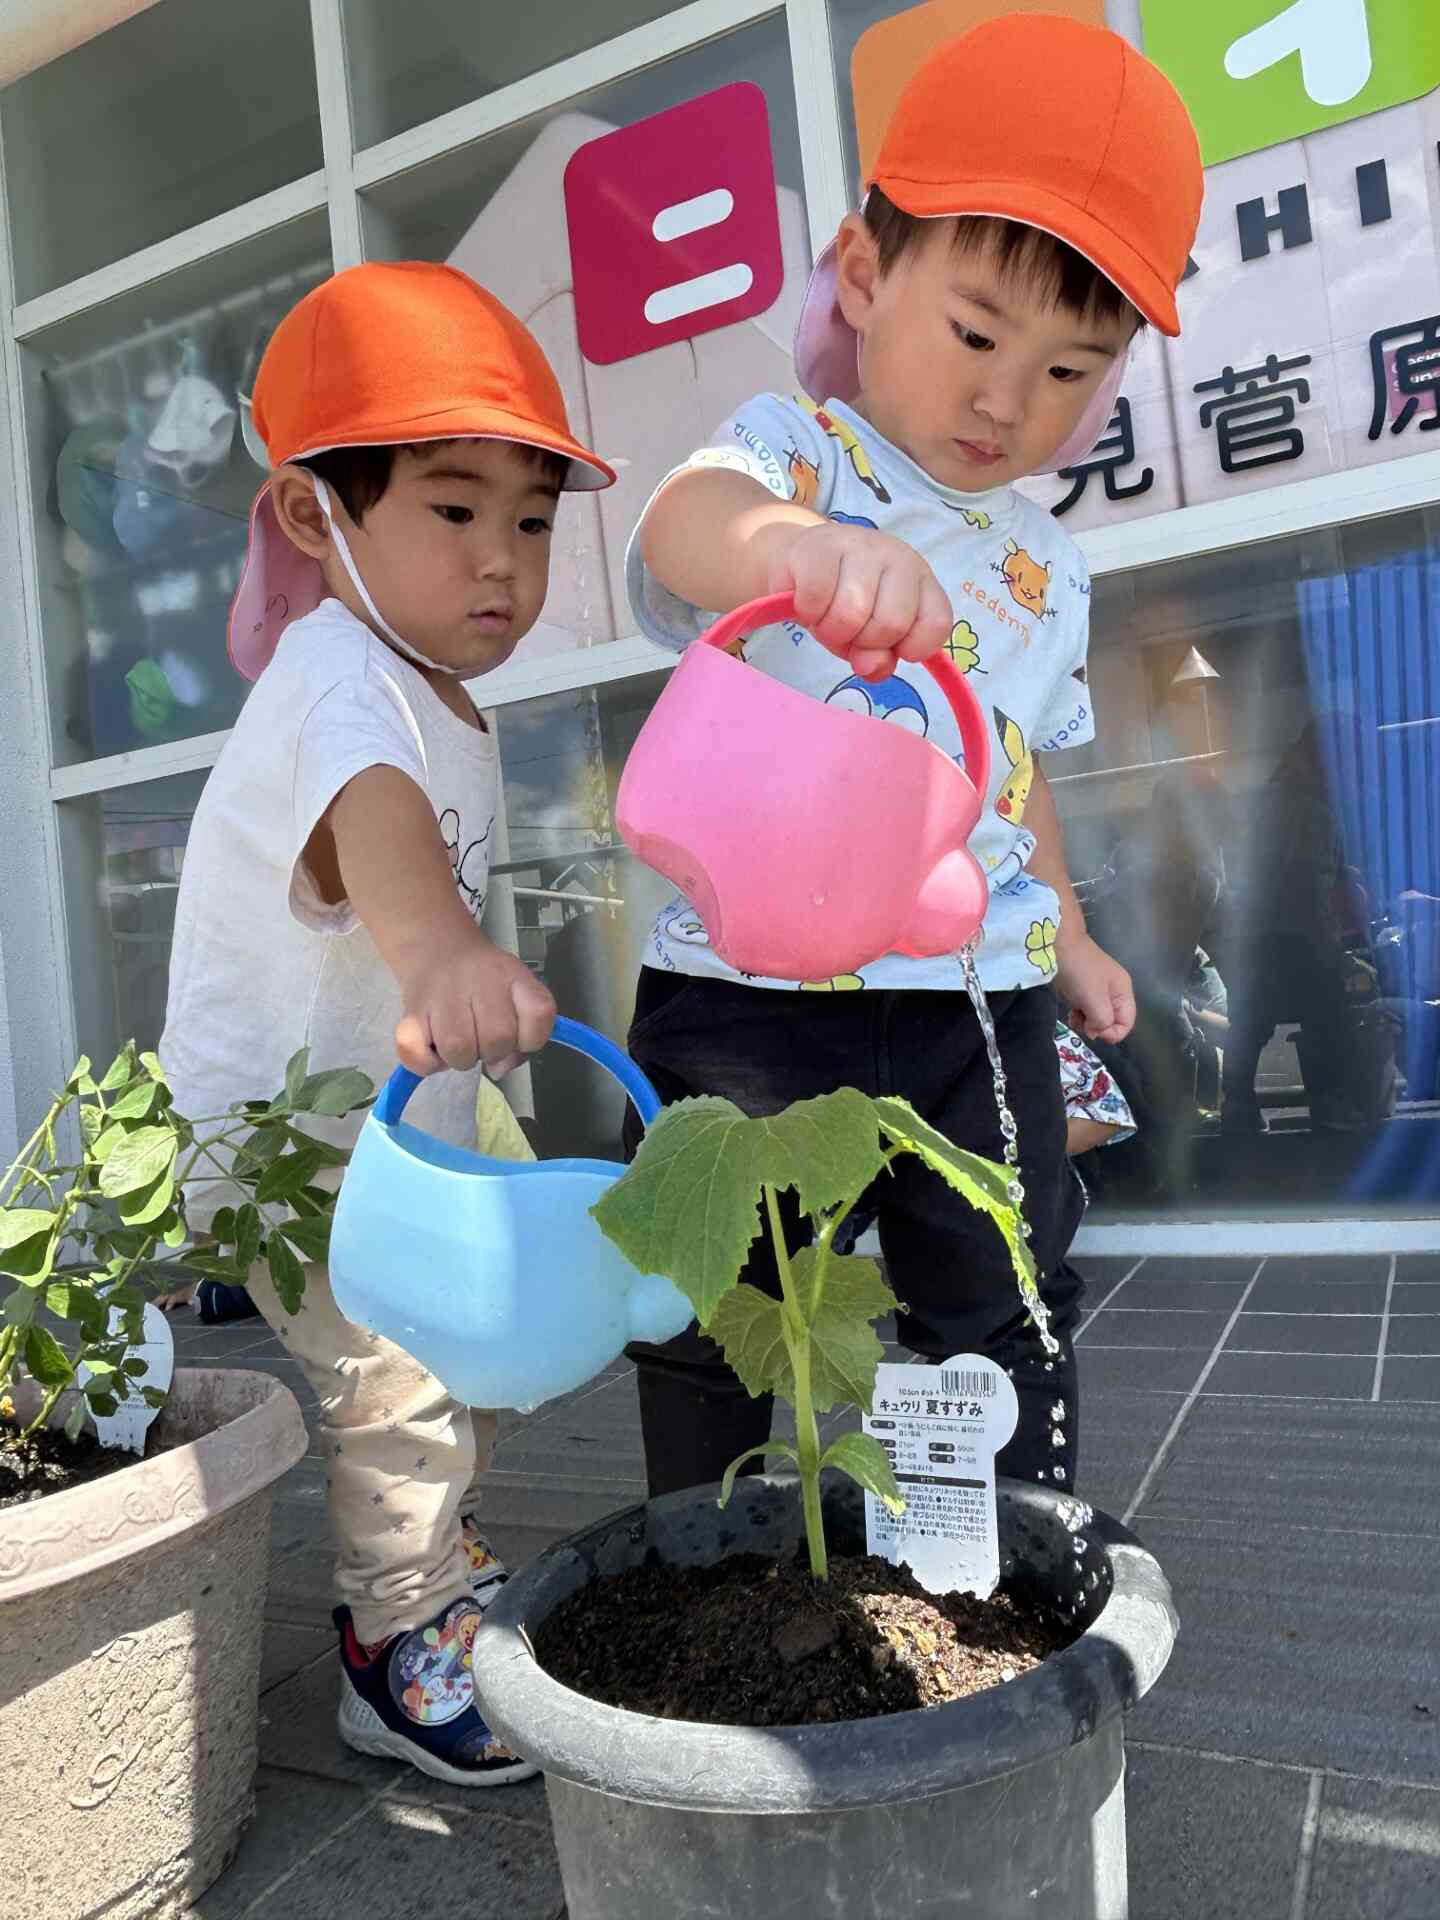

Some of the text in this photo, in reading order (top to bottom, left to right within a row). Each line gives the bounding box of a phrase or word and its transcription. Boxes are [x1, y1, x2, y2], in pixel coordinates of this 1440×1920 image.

[880, 1399, 983, 1417] キュウリ 夏すずみ
